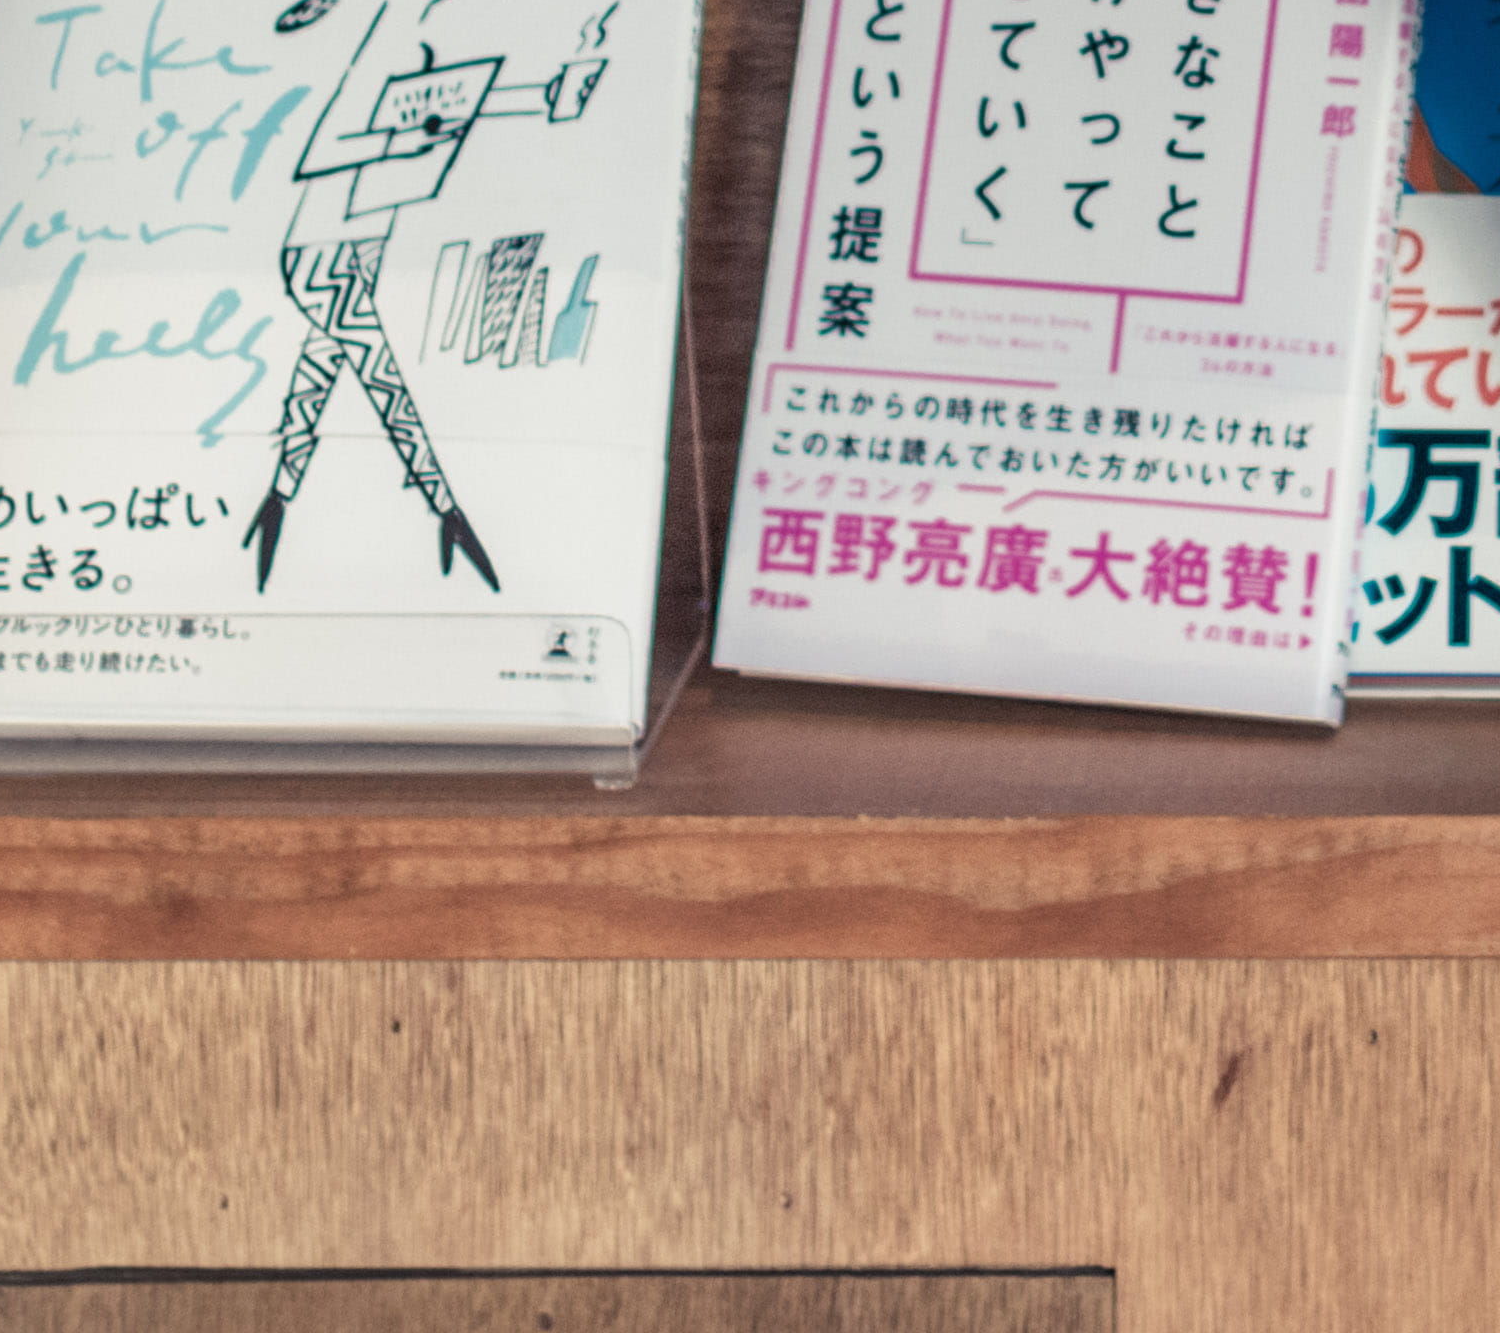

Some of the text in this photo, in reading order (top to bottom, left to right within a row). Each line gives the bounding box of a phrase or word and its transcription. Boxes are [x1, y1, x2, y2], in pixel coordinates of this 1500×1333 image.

[134, 85, 313, 202] off
[12, 252, 276, 448] heels
[785, 385, 1312, 451] これからの時代を生き残りたければ
[751, 468, 935, 505] キングコング
[770, 430, 1315, 499] この本は読んでおいた方がいいです。
